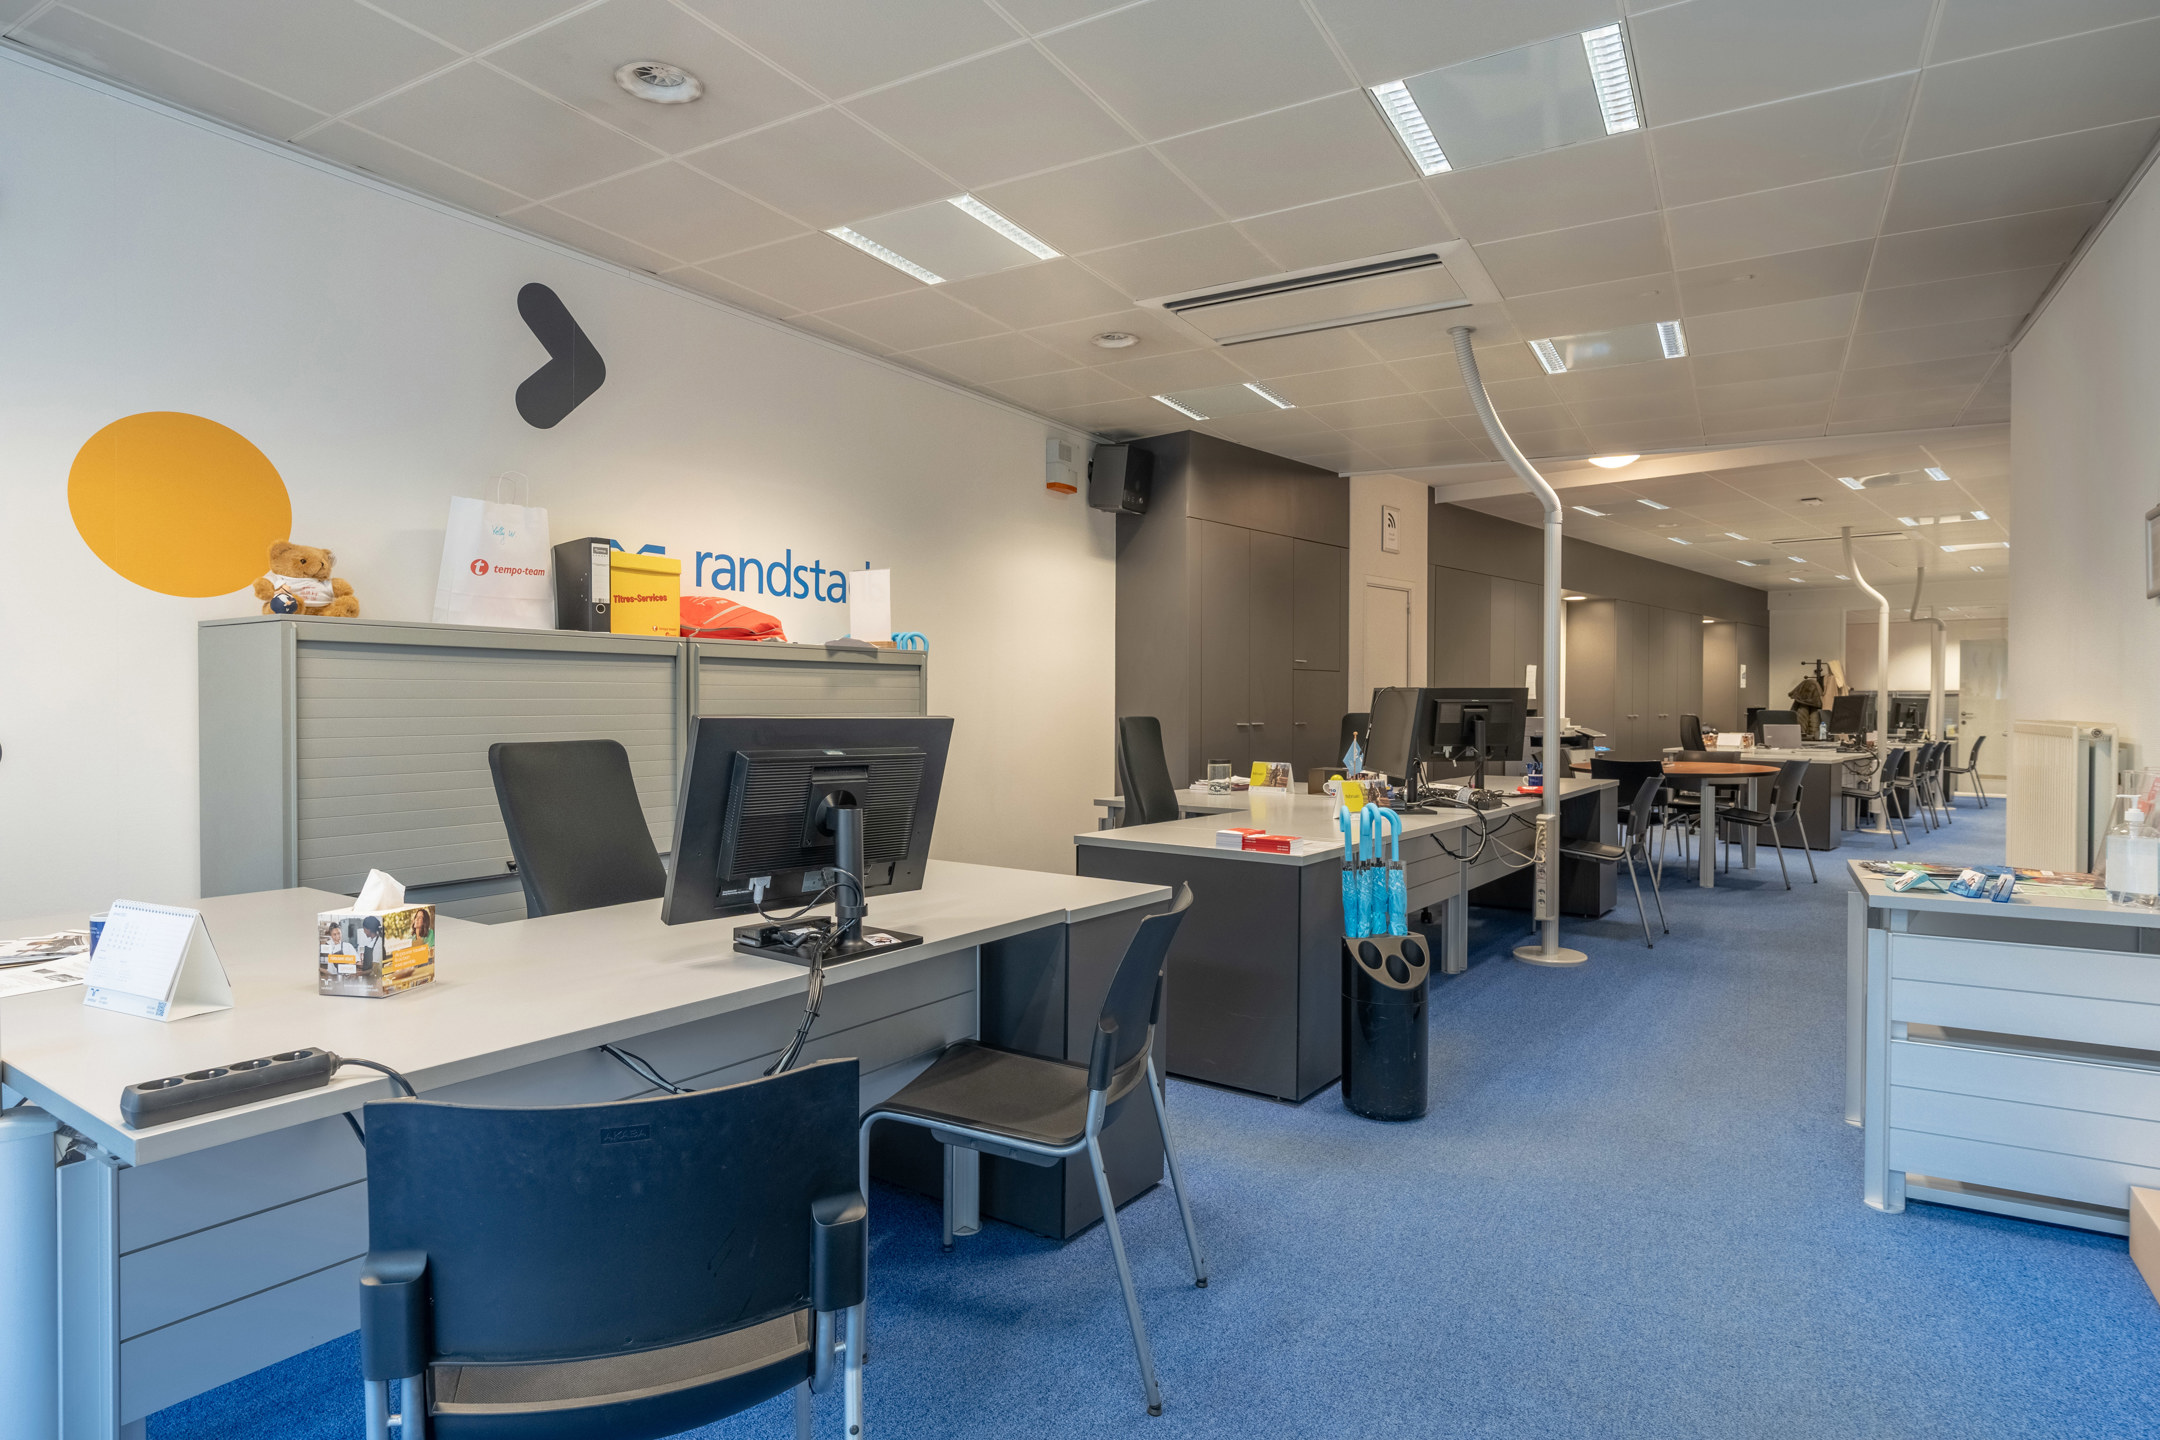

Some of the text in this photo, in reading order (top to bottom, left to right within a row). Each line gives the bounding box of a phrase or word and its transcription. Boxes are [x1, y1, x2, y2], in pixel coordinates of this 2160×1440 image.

[494, 565, 546, 576] tempo-team
[695, 548, 870, 603] randsta
[613, 593, 668, 604] Titres-Services
